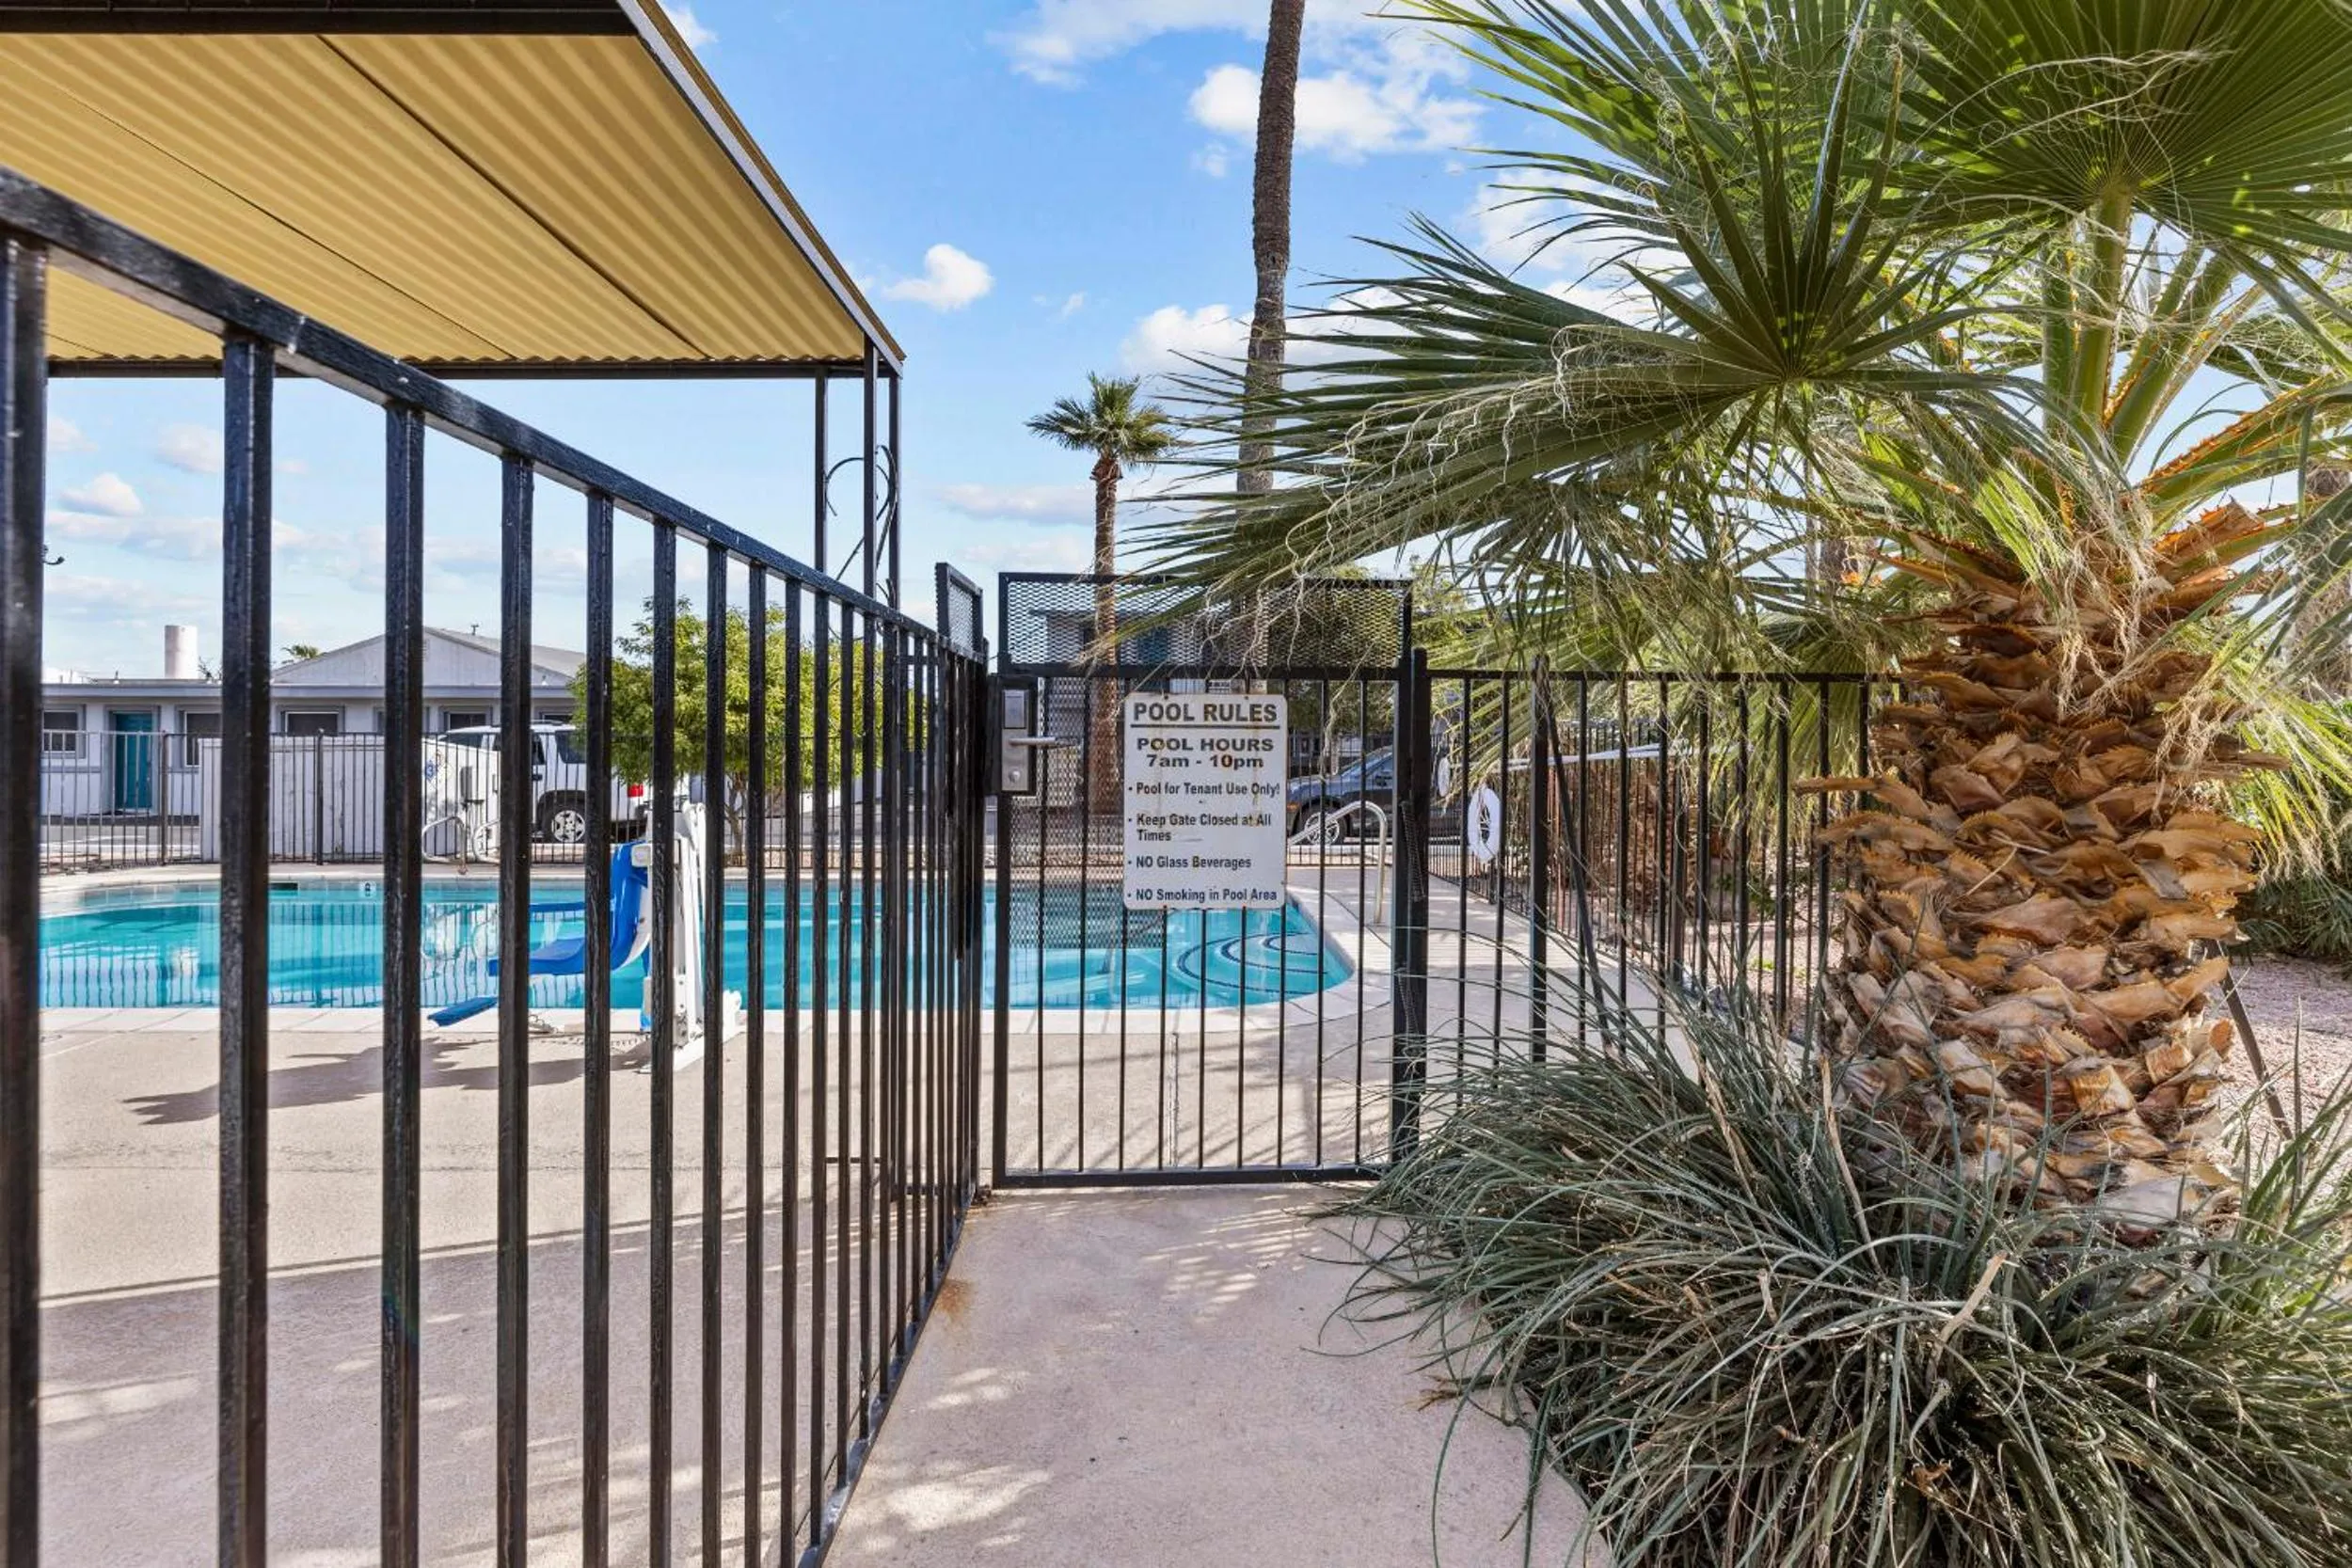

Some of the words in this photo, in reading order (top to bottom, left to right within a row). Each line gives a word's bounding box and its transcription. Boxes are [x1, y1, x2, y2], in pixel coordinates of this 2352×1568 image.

[1134, 703, 1195, 721] POOL
[1203, 703, 1277, 721] RULES
[1136, 737, 1194, 751] POOL
[1200, 737, 1274, 752] HOURS
[1146, 753, 1189, 768] 7am
[1210, 754, 1263, 770] 10pm
[1136, 783, 1161, 794] Pool
[1165, 783, 1180, 794] for
[1184, 783, 1222, 795] Tenant
[1226, 783, 1247, 795] Use
[1251, 783, 1280, 798] Only!
[1136, 814, 1166, 828] Keep
[1169, 814, 1196, 826] Gate
[1200, 814, 1237, 826] Closed
[1242, 816, 1253, 826] at
[1257, 814, 1271, 826] All
[1136, 830, 1171, 841] Times
[1136, 857, 1152, 867] NO
[1157, 856, 1187, 867] Glass
[1193, 856, 1251, 870] Beverages
[1136, 890, 1152, 900] NO
[1157, 889, 1204, 903] Smoking
[1209, 889, 1218, 900] in
[1223, 889, 1247, 900] Pool
[1250, 889, 1277, 901] Area
